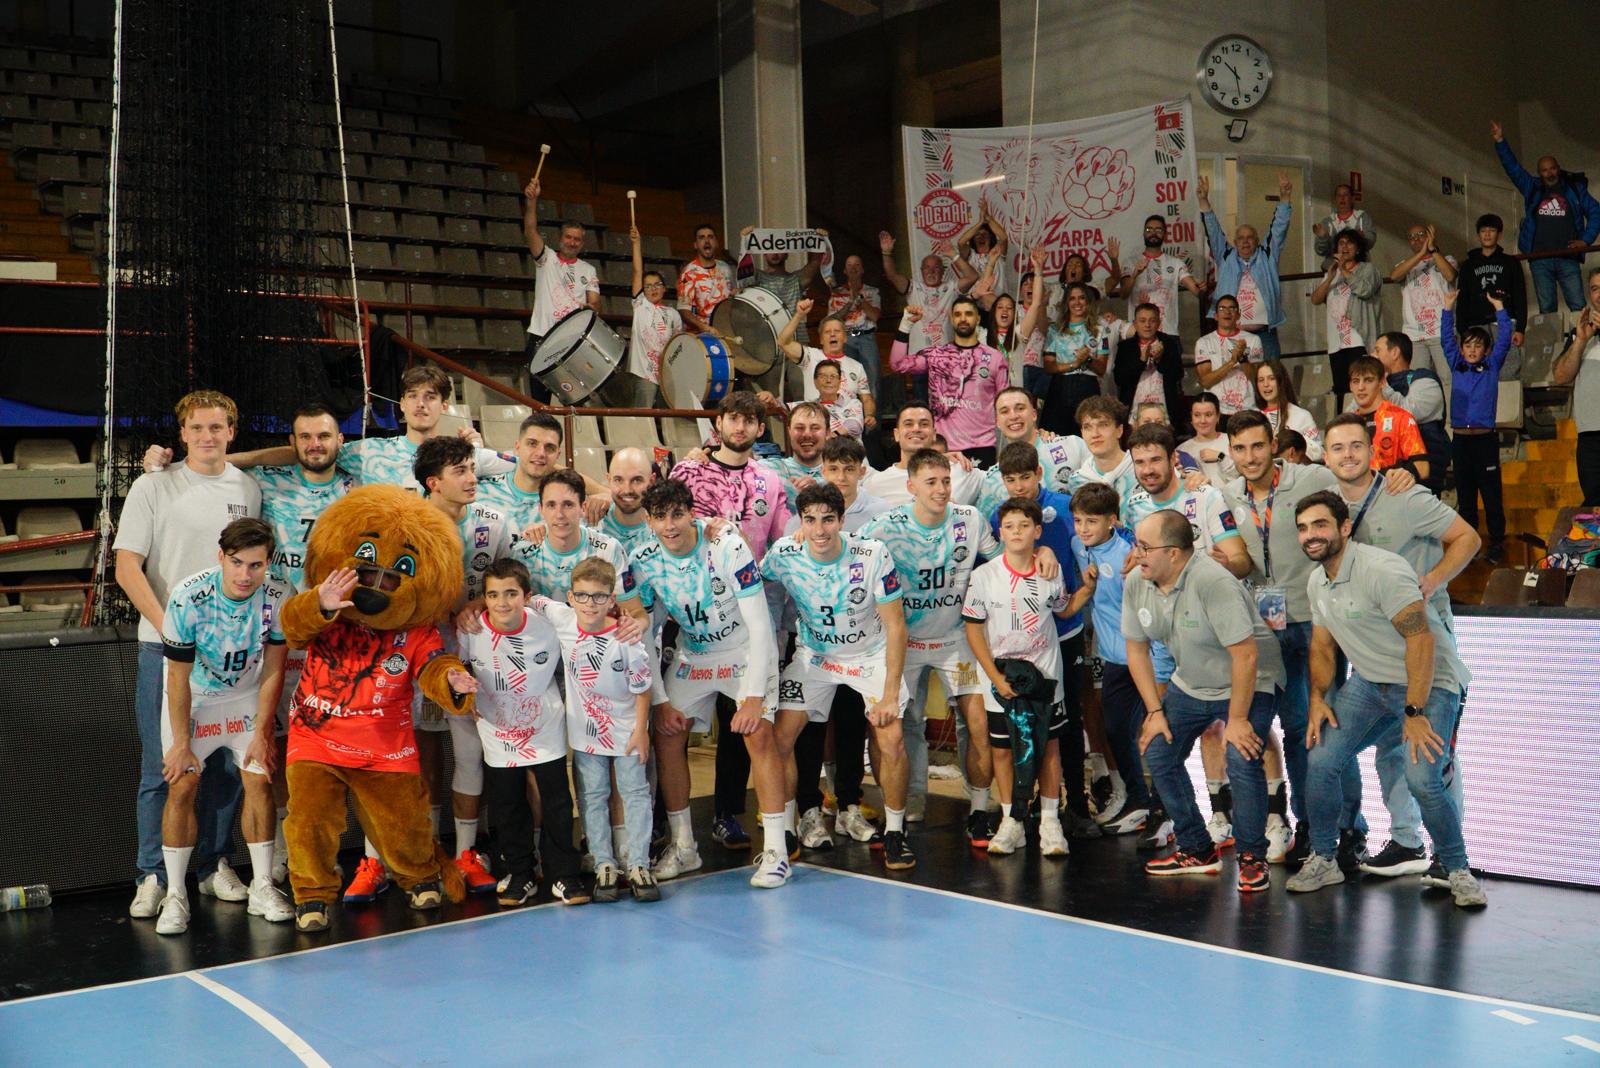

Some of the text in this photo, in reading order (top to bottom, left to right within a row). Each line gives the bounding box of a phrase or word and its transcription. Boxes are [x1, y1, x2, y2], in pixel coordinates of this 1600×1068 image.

[1221, 46, 1229, 55] 11
[1231, 44, 1242, 53] 12
[1212, 55, 1222, 64] 10
[1253, 58, 1260, 67] 2
[1207, 68, 1215, 77] 9
[1257, 72, 1264, 81] 3
[1211, 82, 1219, 91] 8
[1252, 85, 1260, 93] 4
[1220, 92, 1226, 100] 7
[1231, 97, 1239, 106] 6
[1244, 94, 1251, 103] 5
[1165, 166, 1178, 179] YO
[1155, 180, 1188, 203] SOY
[1453, 183, 1465, 195] WC
[1167, 204, 1180, 216] DE
[1538, 208, 1566, 216] adidas
[785, 230, 816, 238] Balonm
[1043, 212, 1105, 247] ZARPA
[1162, 217, 1196, 244] EÓN
[747, 233, 825, 251] Ademar
[227, 503, 248, 517] MOTOR
[300, 518, 315, 543] 7
[850, 546, 873, 557] alsa
[918, 565, 946, 591] 30
[902, 594, 963, 610] ABANCA
[684, 600, 710, 627] 14
[820, 605, 836, 627] 3
[223, 649, 249, 672] 19
[195, 715, 245, 740] huevos león
